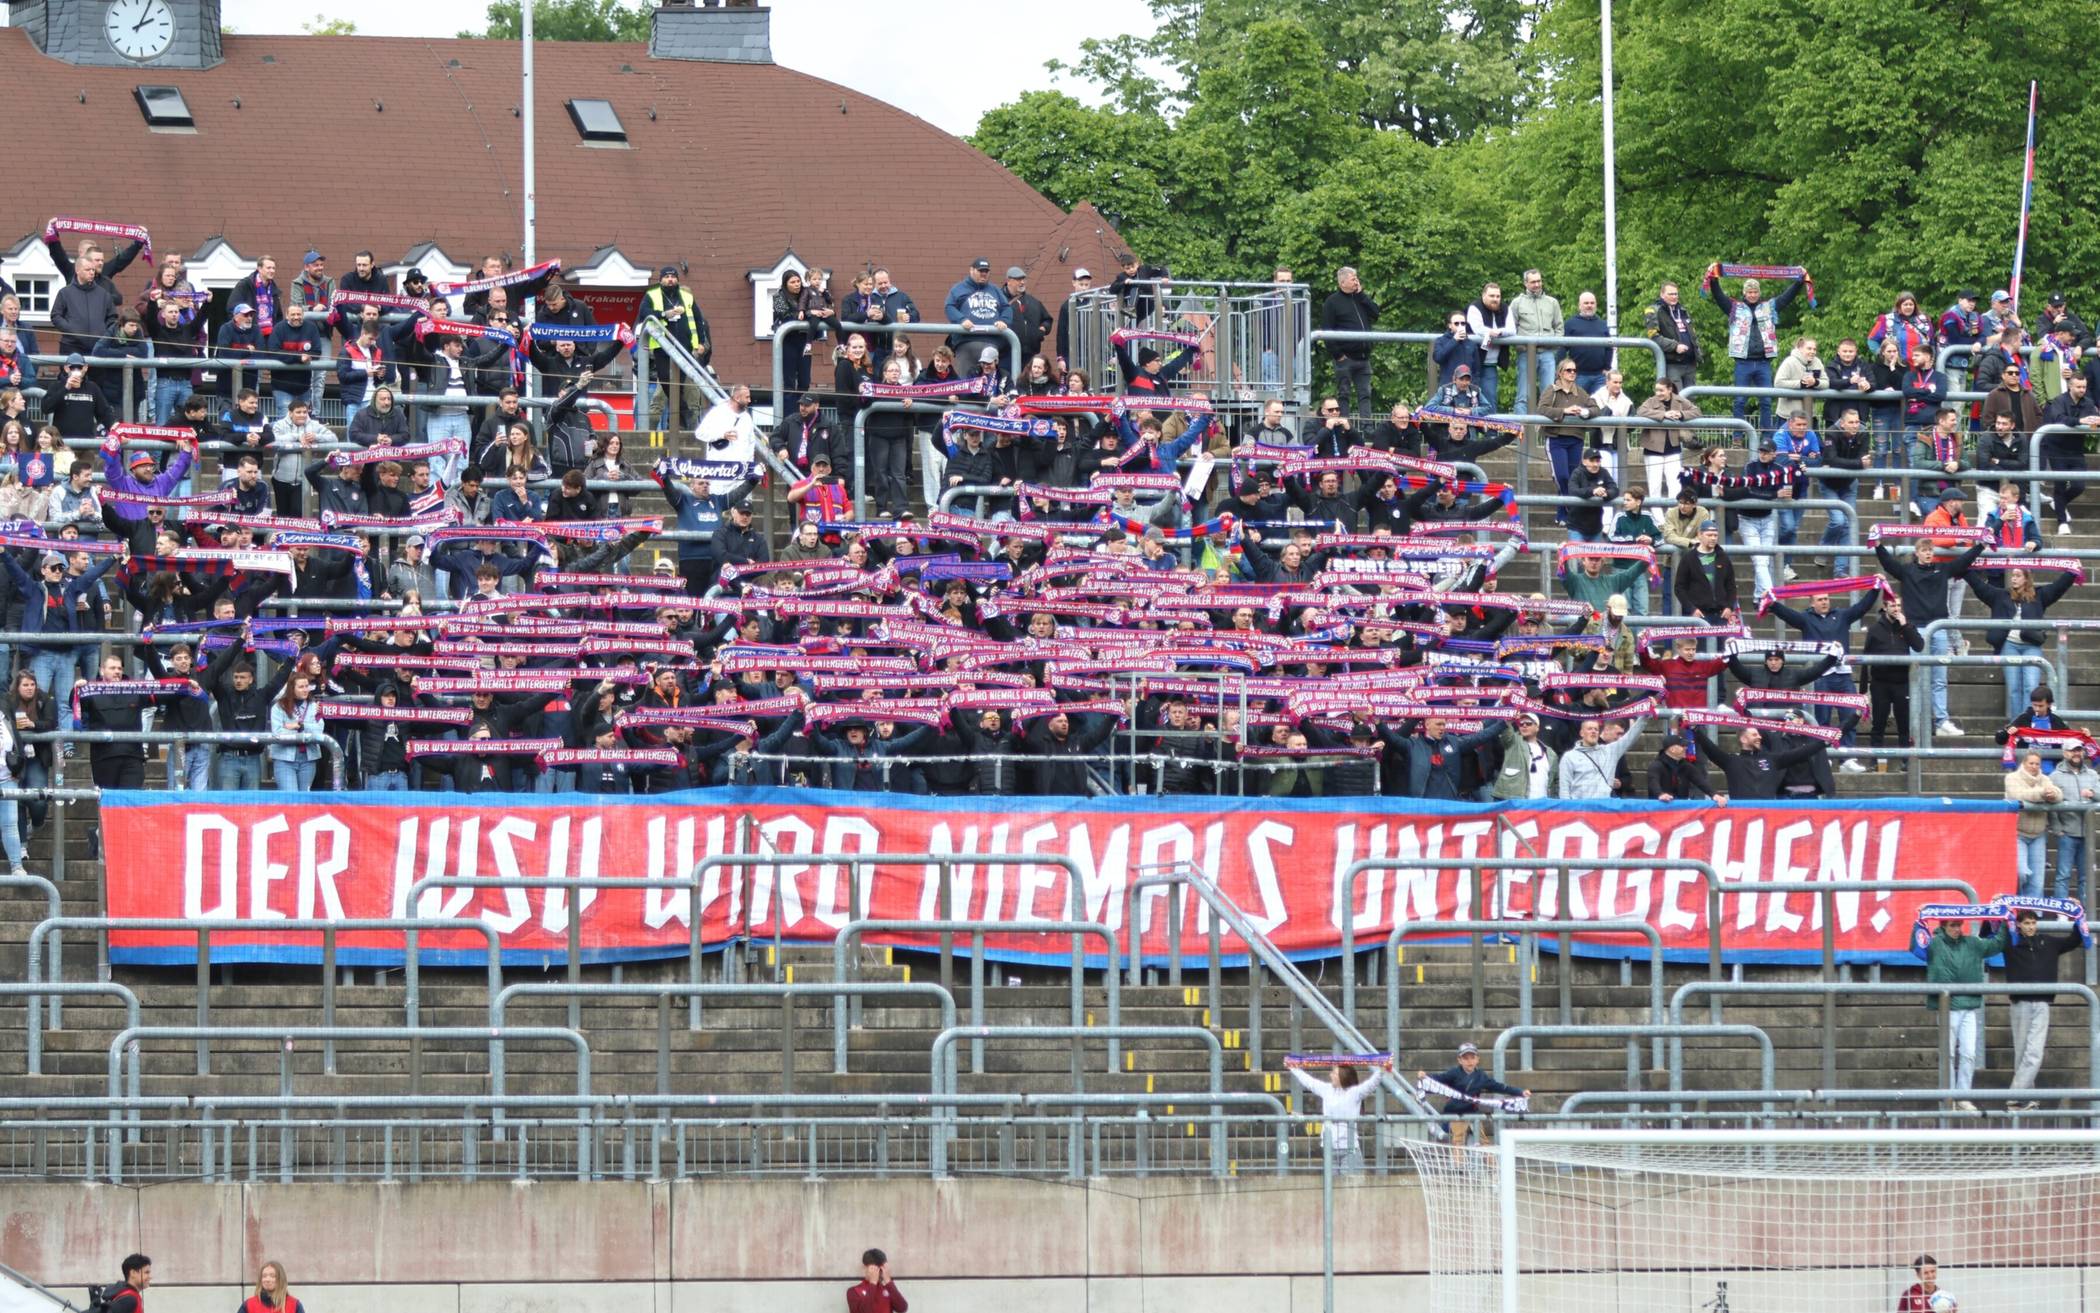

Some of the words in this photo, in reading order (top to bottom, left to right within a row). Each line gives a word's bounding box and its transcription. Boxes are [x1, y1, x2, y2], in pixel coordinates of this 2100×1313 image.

[94, 223, 123, 234] NIEMALS
[369, 295, 398, 304] NIEMALS
[583, 295, 636, 304] Krakauer
[439, 322, 510, 341] Wuppertaler
[532, 327, 597, 337] WUPPERTALER
[599, 328, 611, 337] SV
[145, 428, 179, 437] WIEDER
[353, 448, 403, 461] WUPPERTALER
[678, 460, 739, 480] Wuppertal
[1304, 460, 1324, 470] WIRD
[1326, 459, 1356, 469] NIEMALS
[101, 490, 116, 499] DER
[186, 510, 200, 520] DER
[201, 511, 218, 521] WSV
[220, 512, 240, 523] WIRD
[242, 513, 271, 525] NIEMALS
[951, 516, 970, 527] WIRD
[1882, 526, 1932, 535] WUPPERTALER
[1986, 558, 2006, 566] WIRD
[2009, 558, 2039, 567] NIEMALS
[542, 575, 558, 584] DER
[560, 575, 577, 584] WSV
[811, 573, 824, 583] DER
[825, 572, 840, 581] WSV
[1339, 572, 1359, 582] WIRD
[1362, 573, 1393, 582] NIEMALS
[480, 603, 496, 612] WSV
[519, 599, 547, 609] NIEMALS
[621, 594, 638, 603] WSV
[641, 595, 662, 604] WIRD
[664, 595, 696, 606] NIEMALS
[1158, 596, 1212, 606] WUPPERTALER
[1214, 595, 1264, 605] SPORTVEREIN
[797, 603, 813, 612] WSV
[815, 603, 835, 613] WIRD
[837, 604, 867, 613] NIEMALS
[333, 622, 349, 631] DER
[351, 621, 369, 631] WSV
[394, 618, 425, 628] NIEMALS
[463, 624, 480, 633] WSV
[505, 625, 535, 634] NIEMALS
[537, 625, 586, 635] UNTERGEHEN!
[1078, 630, 1135, 639] WUPPERTALER
[439, 643, 454, 653] DER
[457, 643, 473, 653] WSV
[475, 643, 496, 653] WIRD
[500, 644, 532, 654] NIEMALS
[593, 640, 610, 650] WSV
[612, 640, 632, 650] WIRD
[634, 641, 664, 651] NIEMALS
[1125, 649, 1145, 659] WIRD
[354, 656, 372, 665] WSV
[375, 656, 396, 665] WIRD
[738, 658, 754, 669] WSV
[757, 658, 777, 669] WIRD
[779, 658, 810, 669] NIEMALS
[978, 655, 994, 666] WSV
[1059, 660, 1113, 671] WUPPERTALER
[1115, 660, 1165, 670] SPORTVEREIN
[419, 681, 434, 690] DER
[436, 680, 454, 690] WSV
[457, 680, 477, 689] WIRD
[480, 679, 512, 689] NIEMALS
[514, 679, 567, 690] UNTERGEHEN!
[821, 678, 835, 687] DER
[837, 677, 854, 686] WSV
[1551, 676, 1569, 687] WSV
[1570, 675, 1590, 686] WIRD
[1592, 675, 1622, 686] NIEMALS
[950, 692, 965, 704] WSV
[967, 691, 988, 702] WIRD
[989, 689, 1021, 701] NIEMALS
[1316, 691, 1335, 701] WIRD
[1511, 694, 1525, 705] DER
[1747, 689, 1763, 699] WSV
[1766, 689, 1785, 700] WIRD
[322, 706, 337, 716] DER
[339, 707, 357, 716] WSV
[360, 707, 381, 717] WIRD
[383, 708, 415, 719] NIEMALS
[418, 710, 469, 722] UNTERGEHEN!
[815, 705, 833, 716] WSV
[835, 705, 856, 714] WIRD
[1375, 706, 1390, 715] DER
[1392, 706, 1409, 716] WSV
[1412, 706, 1432, 716] WIRD
[1435, 706, 1465, 716] NIEMALS
[1689, 712, 1703, 723] DER
[1726, 714, 1746, 725] WIRD
[414, 743, 429, 752] DER
[432, 742, 449, 752] WSV
[452, 741, 473, 751] WIRD
[475, 741, 508, 751] NIEMALS
[556, 751, 575, 761] WSV
[577, 750, 598, 760] WIRD
[600, 749, 631, 760] NIEMALS
[184, 814, 350, 920] DER
[392, 814, 602, 934] WSV
[644, 814, 880, 930] WIRD
[920, 820, 1292, 936] NIEMALS
[1332, 818, 1902, 934] UNTERGEHEN!
[2064, 902, 2078, 912] SV
